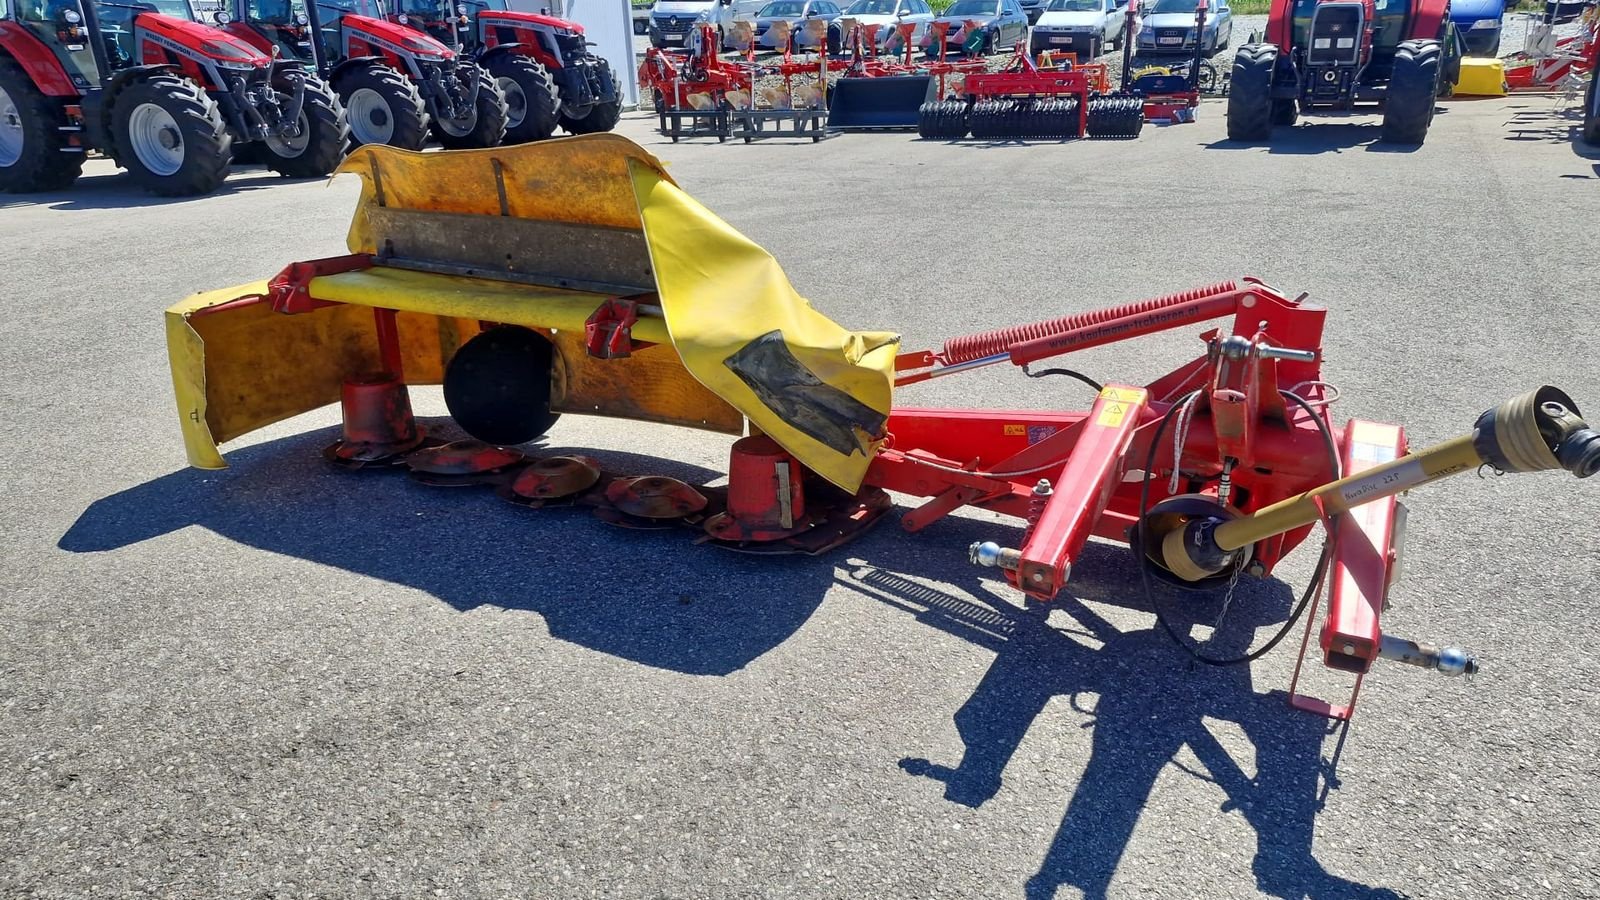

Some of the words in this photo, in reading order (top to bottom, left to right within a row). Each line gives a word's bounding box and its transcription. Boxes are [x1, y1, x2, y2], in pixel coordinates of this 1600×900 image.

[145, 31, 163, 43] MASSEY
[164, 39, 191, 56] FERGUSON
[1049, 305, 1200, 349] www.kaufmann-traktoren.at
